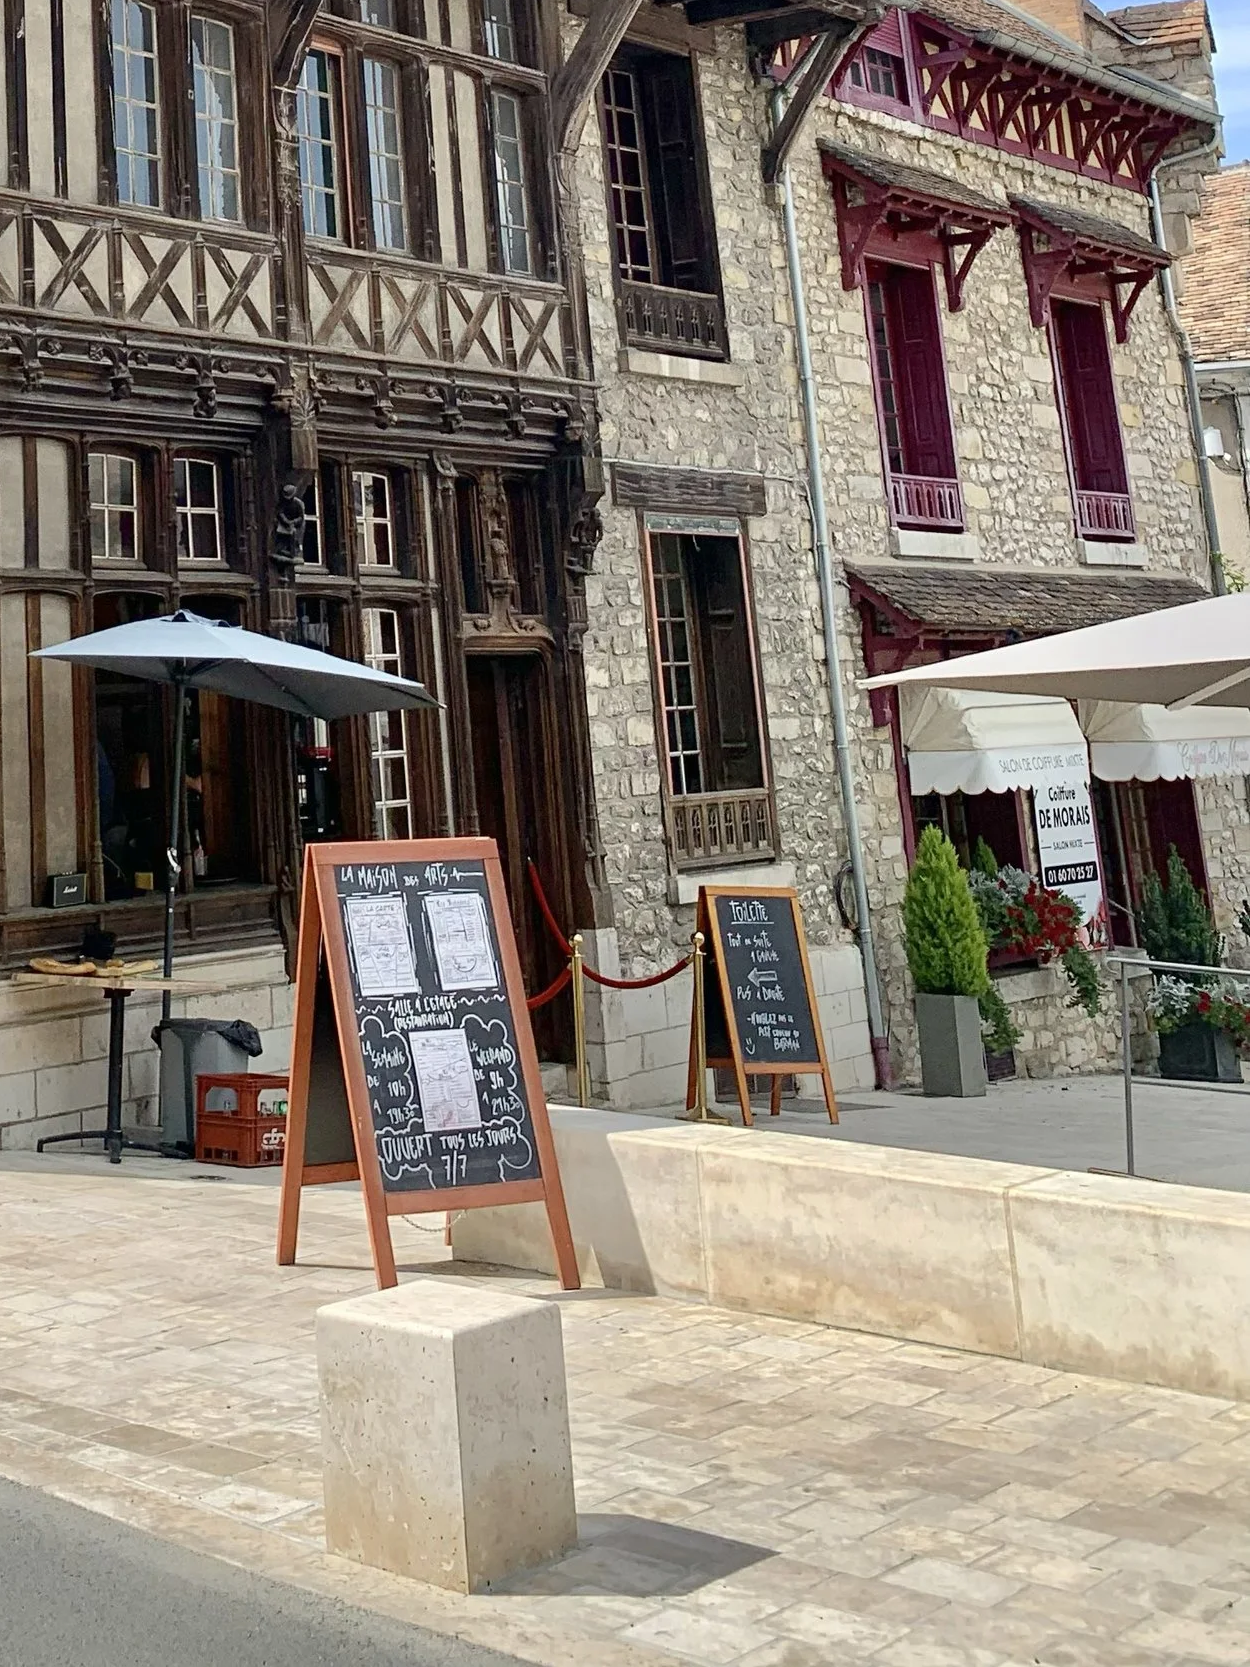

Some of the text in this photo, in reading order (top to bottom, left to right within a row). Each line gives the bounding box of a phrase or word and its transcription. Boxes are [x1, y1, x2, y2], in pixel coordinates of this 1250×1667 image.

[999, 753, 1085, 773] SALON DE COIFFURE MIXTE
[1048, 785, 1076, 802] Coiffure
[1039, 805, 1090, 829] DE MORAIS
[341, 865, 354, 883] LA
[424, 863, 449, 886] ARTS
[1048, 869, 1057, 883] 01
[388, 998, 414, 1018] SALLE
[362, 1040, 372, 1056] LA
[366, 1075, 407, 1097] DE 10h
[473, 1068, 504, 1090] DE 9h
[387, 1107, 415, 1124] 19h30
[491, 1096, 521, 1115] 21h30
[381, 1127, 517, 1164] OUVERT TOUS LES JOURS
[441, 1150, 468, 1185] 7/7
